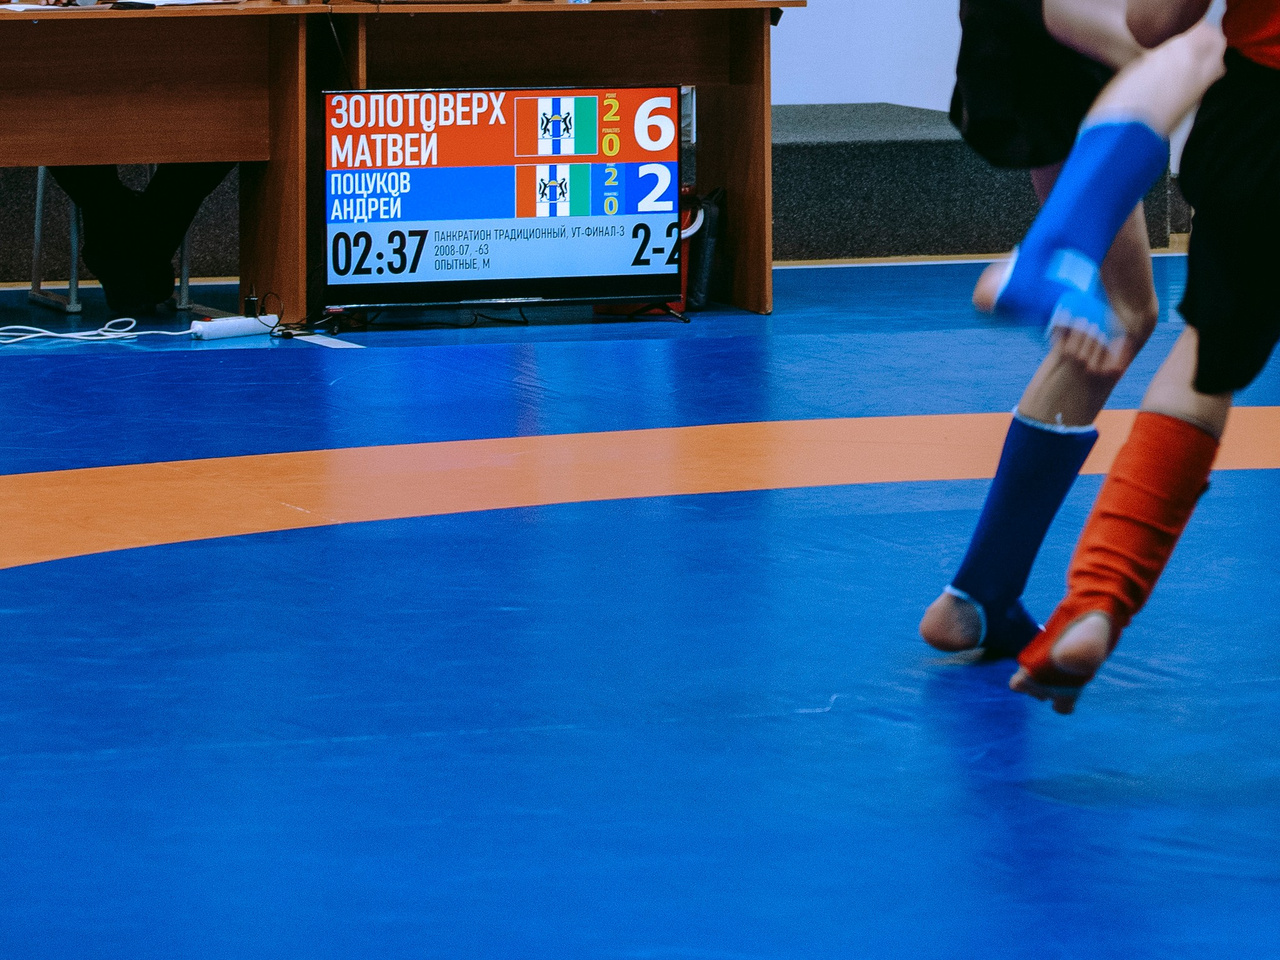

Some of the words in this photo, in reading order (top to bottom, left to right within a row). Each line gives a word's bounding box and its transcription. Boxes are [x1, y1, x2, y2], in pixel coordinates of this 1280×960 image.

[330, 92, 507, 129] ЗОЛОТОВЕРХ
[603, 98, 620, 121] 2
[634, 96, 676, 152] 6
[331, 124, 438, 168] МАТВЕЙ
[602, 133, 620, 157] 0
[331, 171, 411, 198] ПОЦУКОВ
[604, 167, 619, 186] 2
[637, 163, 674, 213] 2
[331, 195, 402, 224] АНДРЕЙ
[604, 196, 619, 215] 0
[434, 229, 492, 242] ПАНКРАТИОН
[494, 225, 569, 241] ТРАДИЦИОННЫЙ,
[631, 221, 679, 266] 2-2
[332, 229, 429, 276] 02:37
[434, 244, 473, 257] 2008-07,
[474, 243, 490, 255] -63
[434, 258, 480, 271] ОПЫТНЫЕ,
[482, 258, 491, 269] М
